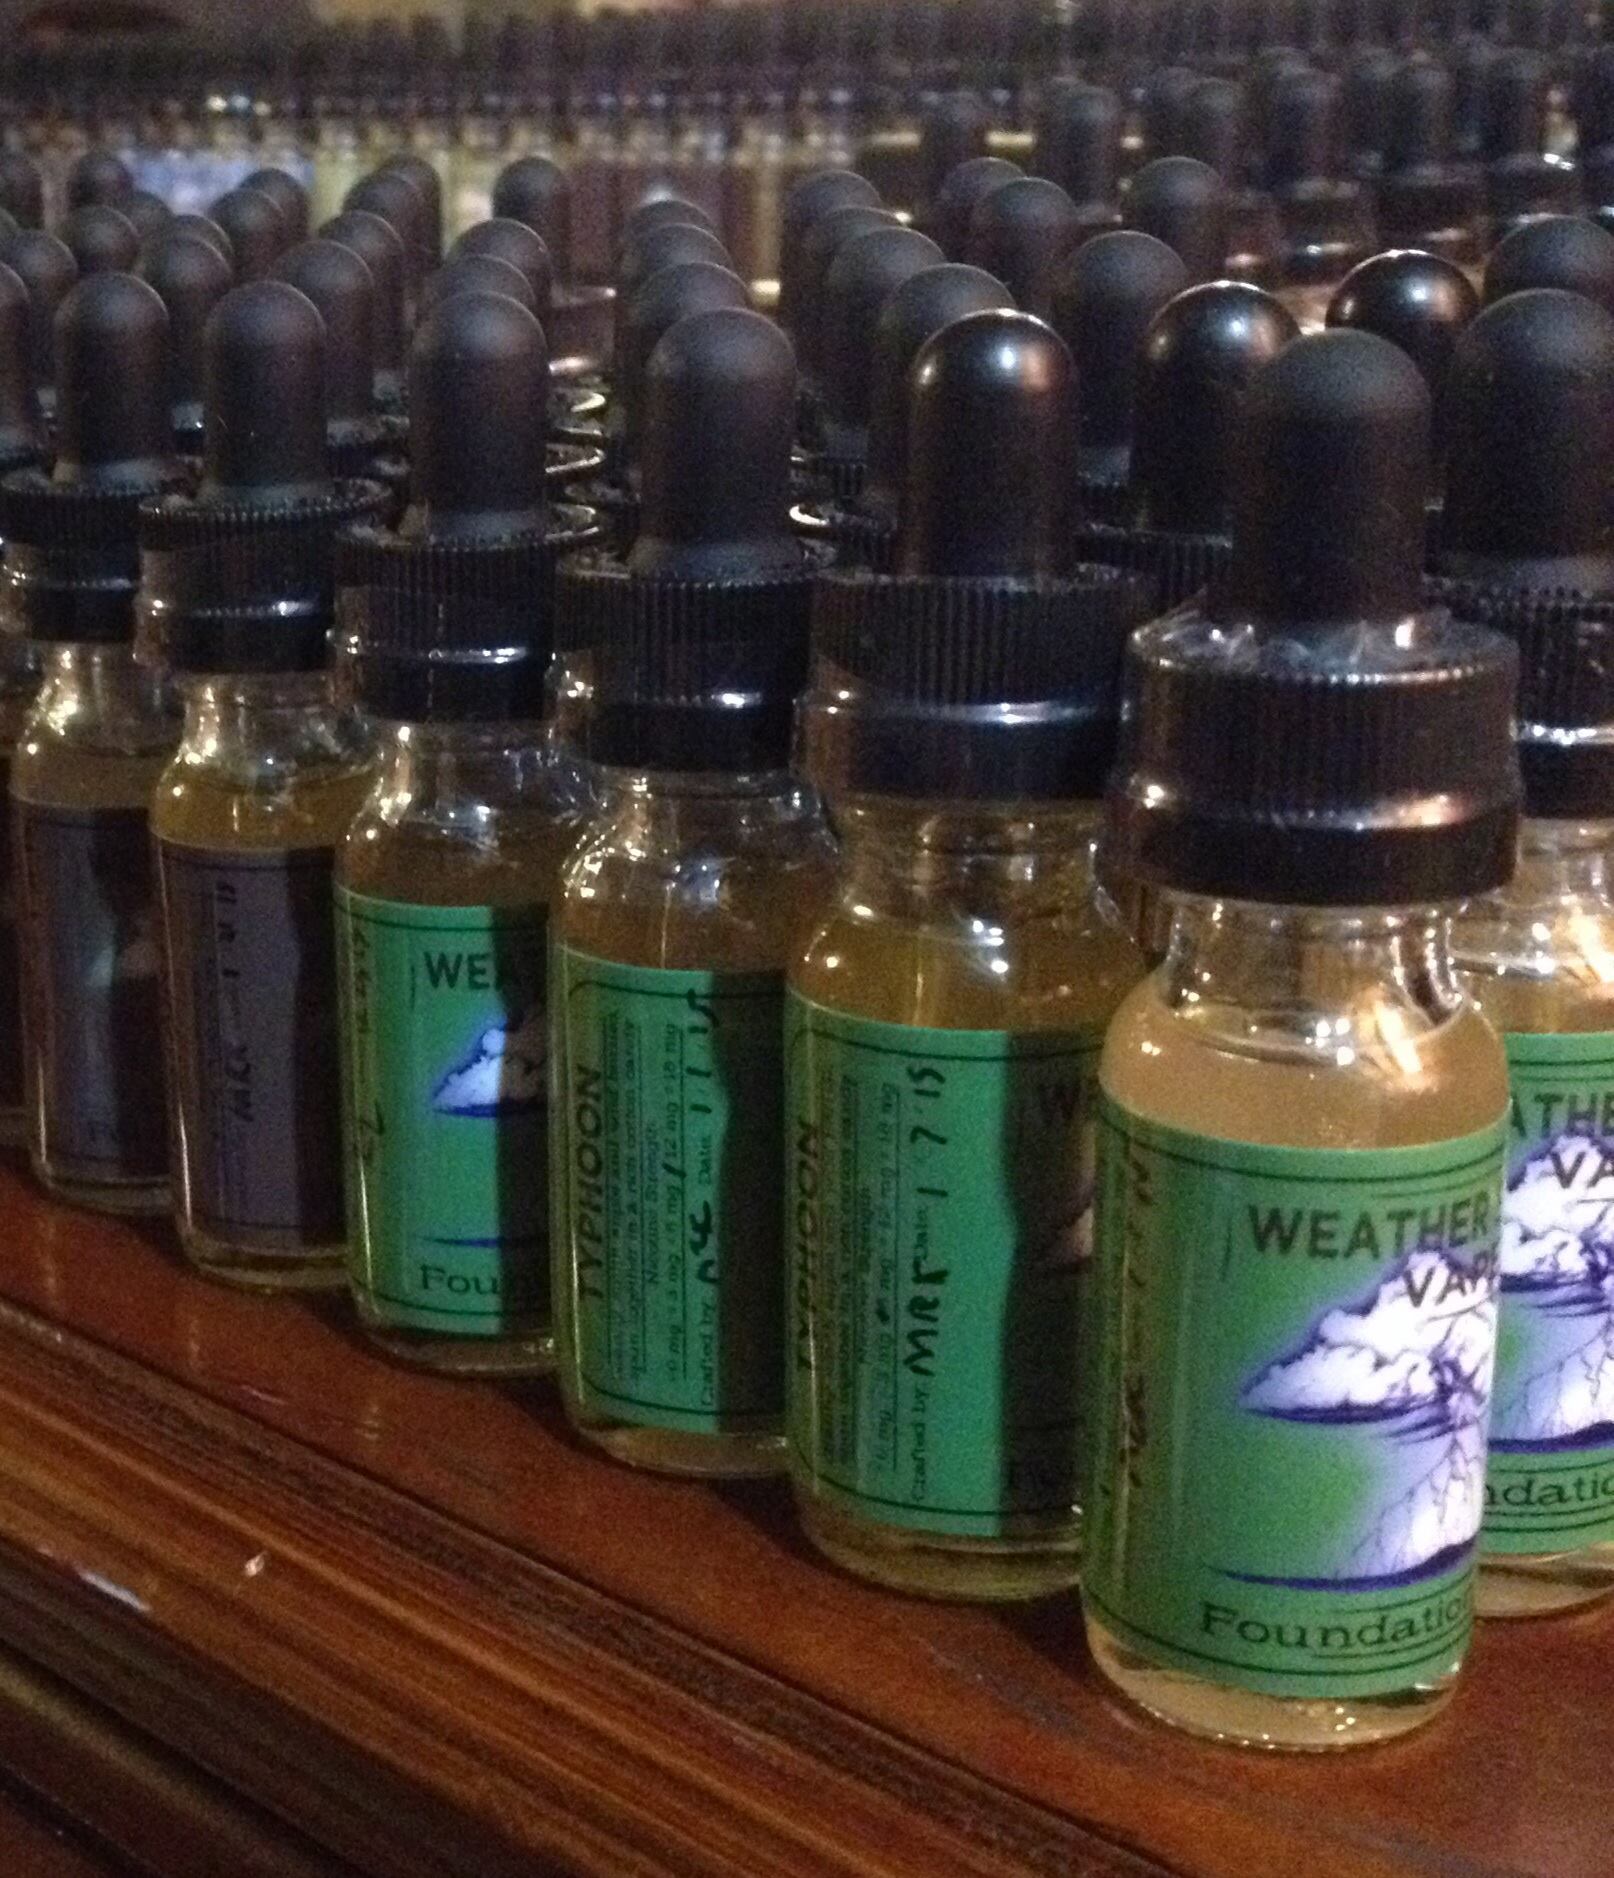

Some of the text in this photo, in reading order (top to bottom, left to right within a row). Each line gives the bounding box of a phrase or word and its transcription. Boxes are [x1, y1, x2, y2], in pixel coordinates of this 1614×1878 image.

[665, 1102, 680, 1132] mg
[663, 1139, 678, 1159] 12
[575, 1064, 605, 1304] TYPHOON
[665, 1184, 681, 1216] mg
[796, 1116, 818, 1372] TYPHOON
[1248, 1189, 1489, 1260] WEATHER
[666, 1253, 681, 1283] mg
[667, 1323, 683, 1355] mg
[698, 1332, 714, 1406] Crafted
[909, 1422, 926, 1503] Crafted
[1200, 1592, 1469, 1648] Foundatio
